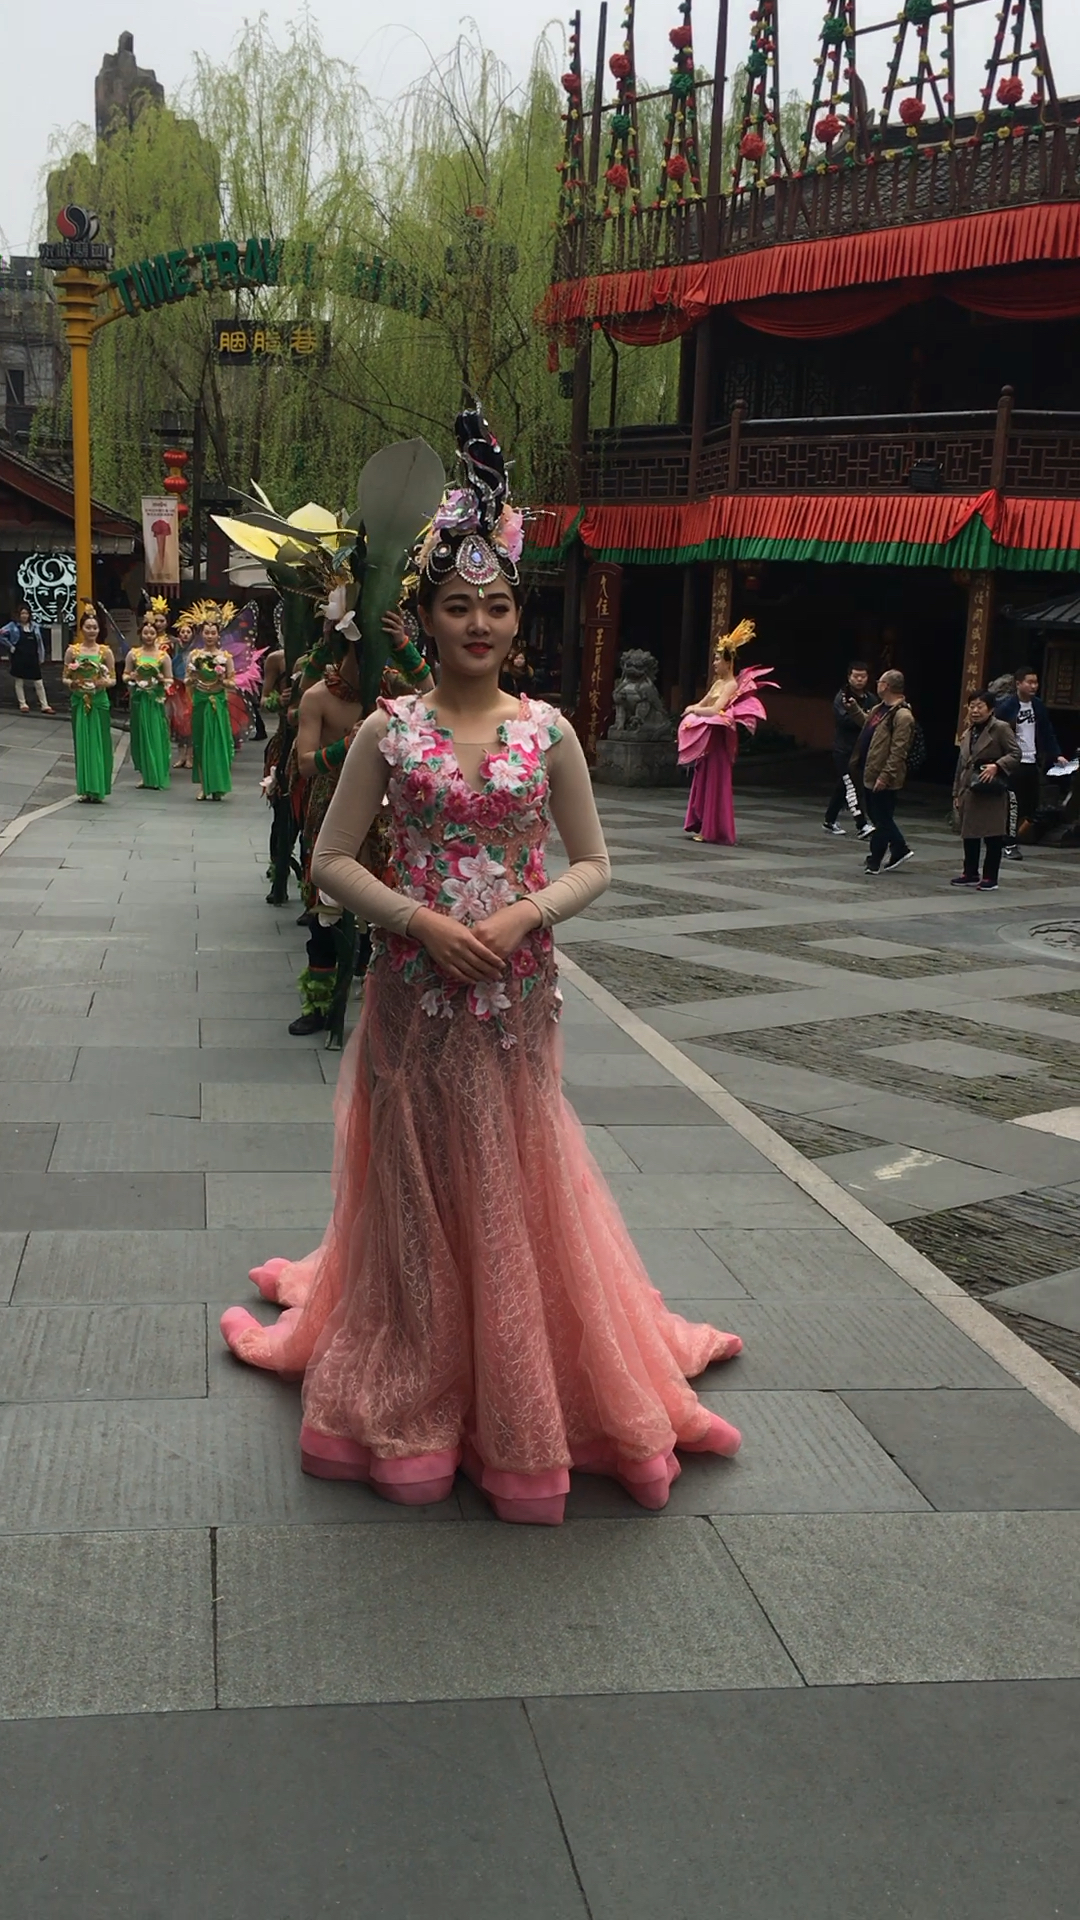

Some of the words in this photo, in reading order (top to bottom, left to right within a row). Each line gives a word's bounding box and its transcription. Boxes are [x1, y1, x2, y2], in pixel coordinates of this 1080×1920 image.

[109, 251, 189, 316] TIME
[218, 326, 317, 354] 胭脂巷
